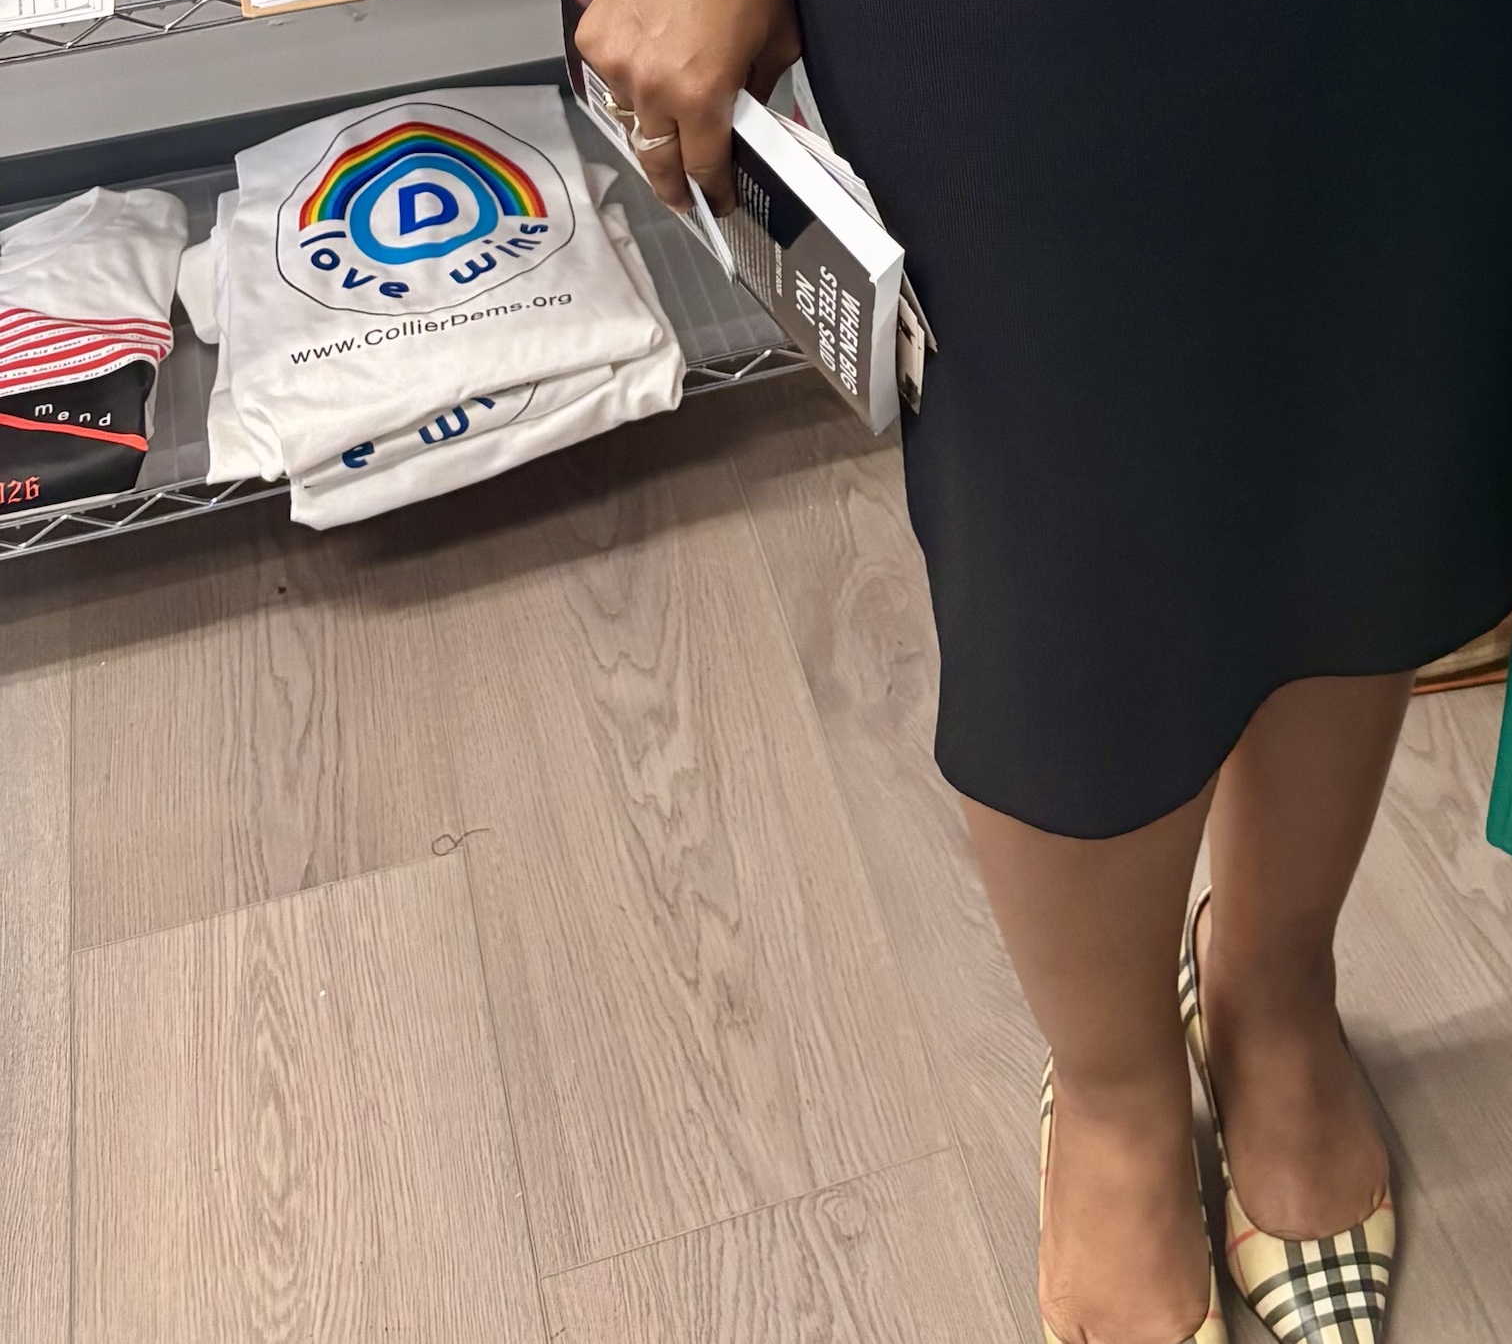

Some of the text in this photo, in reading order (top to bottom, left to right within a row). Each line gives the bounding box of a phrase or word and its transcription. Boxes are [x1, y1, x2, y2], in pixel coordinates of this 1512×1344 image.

[398, 182, 459, 236] D
[300, 223, 548, 298] love wins
[796, 270, 815, 326] NO!
[289, 290, 573, 366] www.CollierDems.org
[819, 266, 838, 372] STEEL SAID
[839, 290, 861, 396] WHEN BIG
[35, 404, 111, 426] mend
